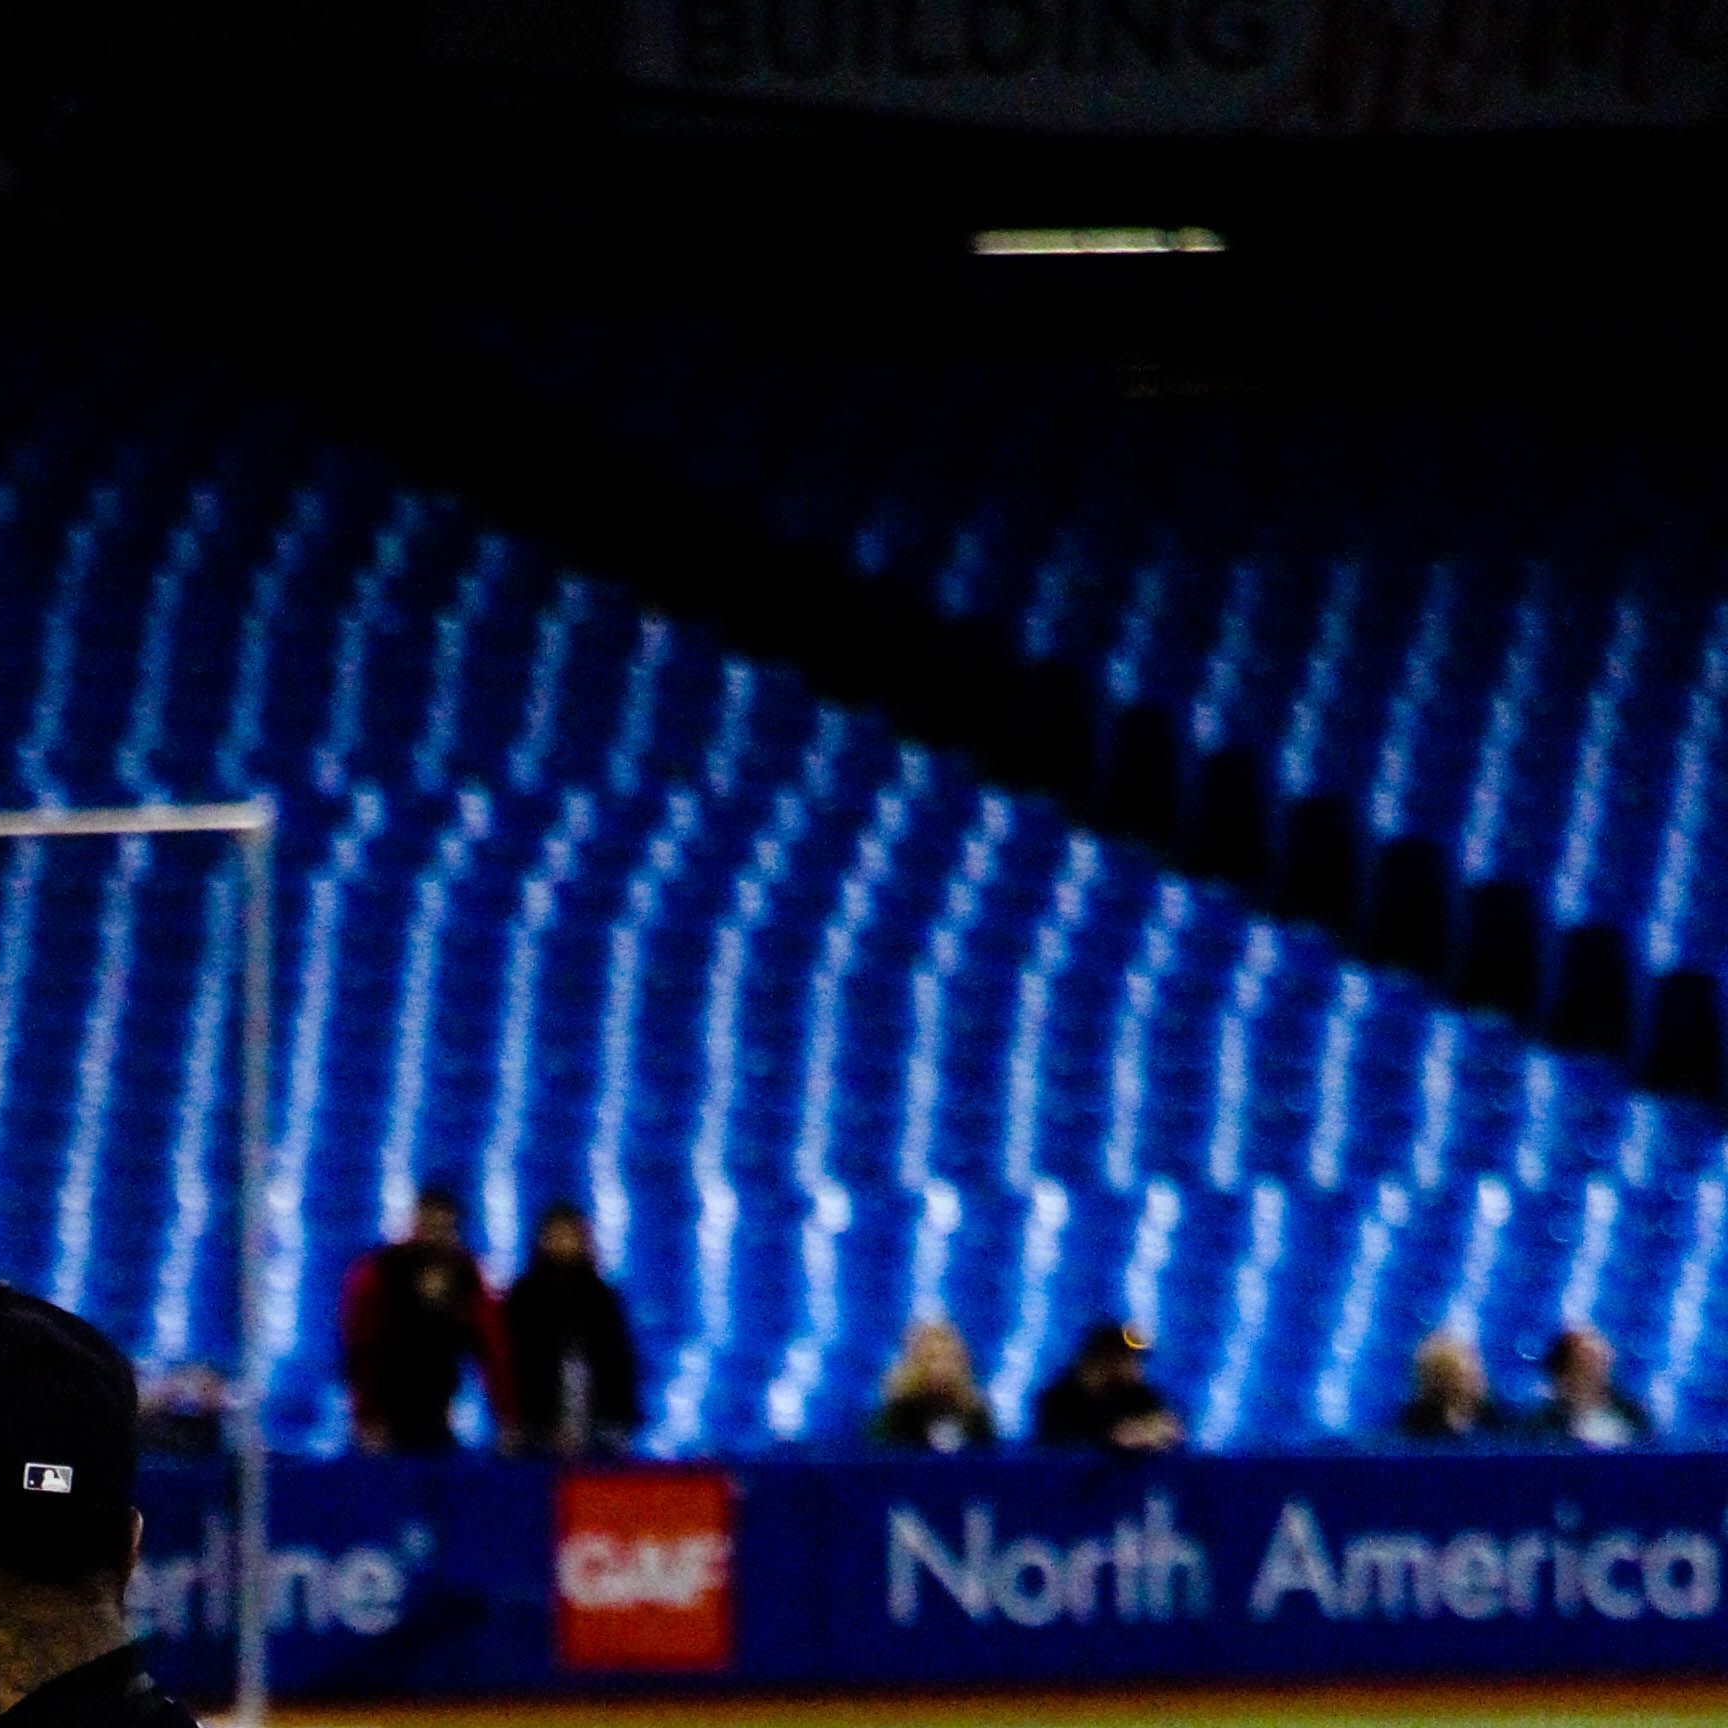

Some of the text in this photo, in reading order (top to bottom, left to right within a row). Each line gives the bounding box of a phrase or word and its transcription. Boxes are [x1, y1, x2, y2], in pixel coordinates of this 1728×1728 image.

[557, 1530, 731, 1610] GAF
[885, 1487, 1720, 1626] North America
